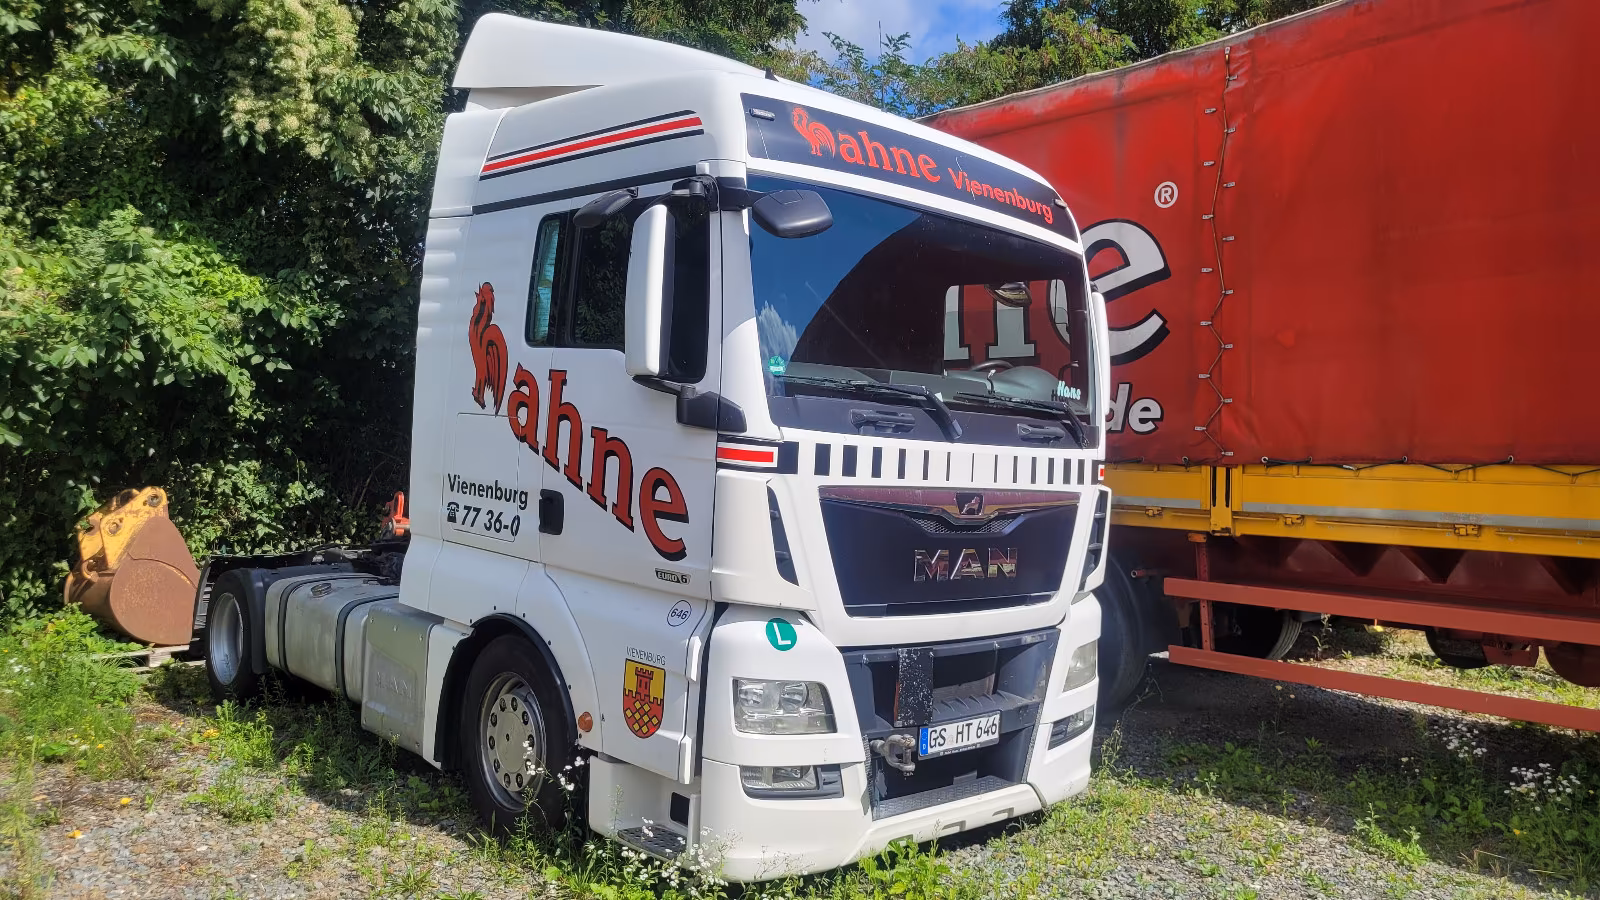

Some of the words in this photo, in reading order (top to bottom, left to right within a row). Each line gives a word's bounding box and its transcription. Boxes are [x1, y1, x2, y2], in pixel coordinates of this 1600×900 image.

[947, 167, 1055, 225] Vienenburg
[447, 473, 529, 511] Vienenburg
[461, 505, 482, 528] 77
[484, 509, 521, 537] 36-0
[657, 571, 678, 583] EURO
[913, 547, 1018, 582] MAN
[670, 608, 689, 620] 646
[773, 622, 792, 645] L
[929, 727, 947, 749] GS
[956, 723, 973, 744] HT
[976, 717, 998, 739] 646
